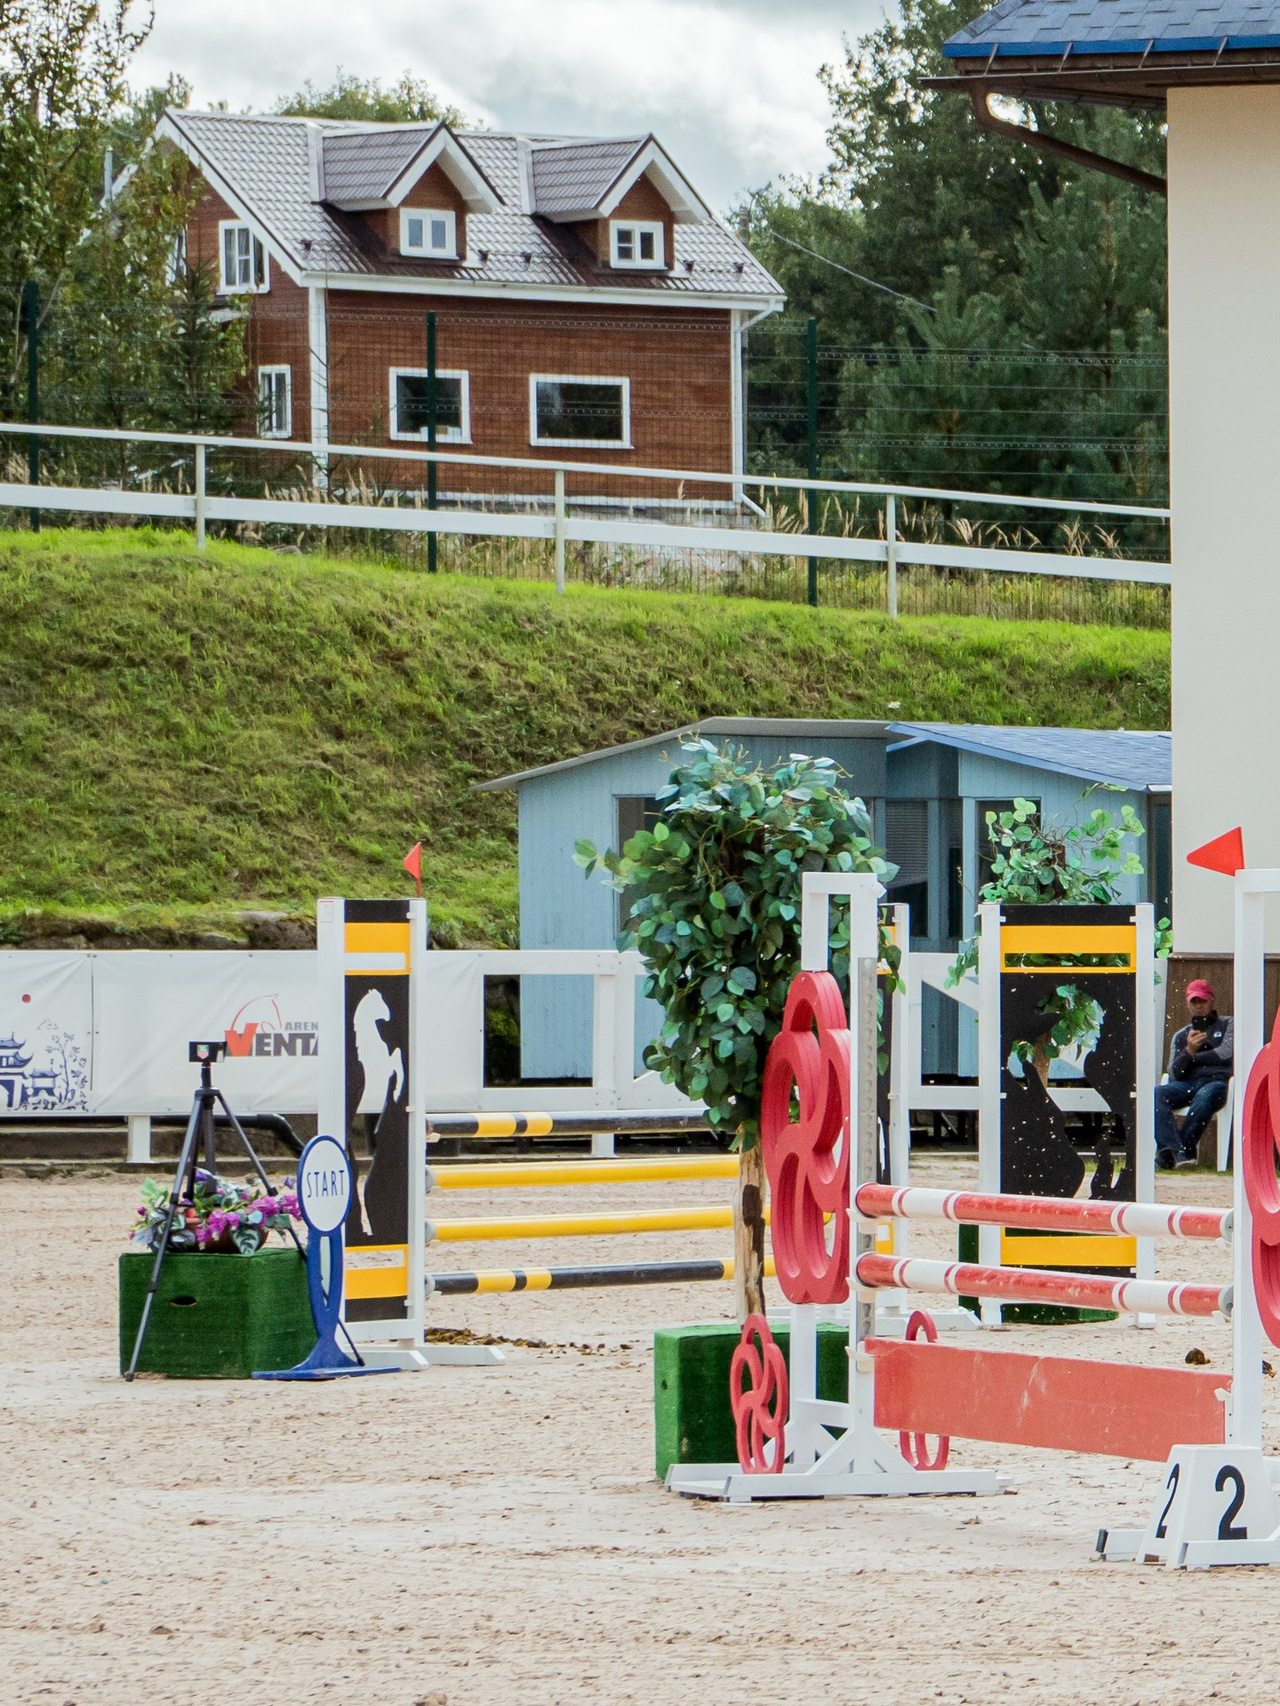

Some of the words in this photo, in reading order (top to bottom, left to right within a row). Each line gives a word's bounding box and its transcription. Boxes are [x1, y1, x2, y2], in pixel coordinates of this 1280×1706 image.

[285, 1021, 318, 1031] AREN
[306, 1169, 345, 1198] START
[1156, 1463, 1179, 1539] 2
[1215, 1465, 1247, 1540] 2
